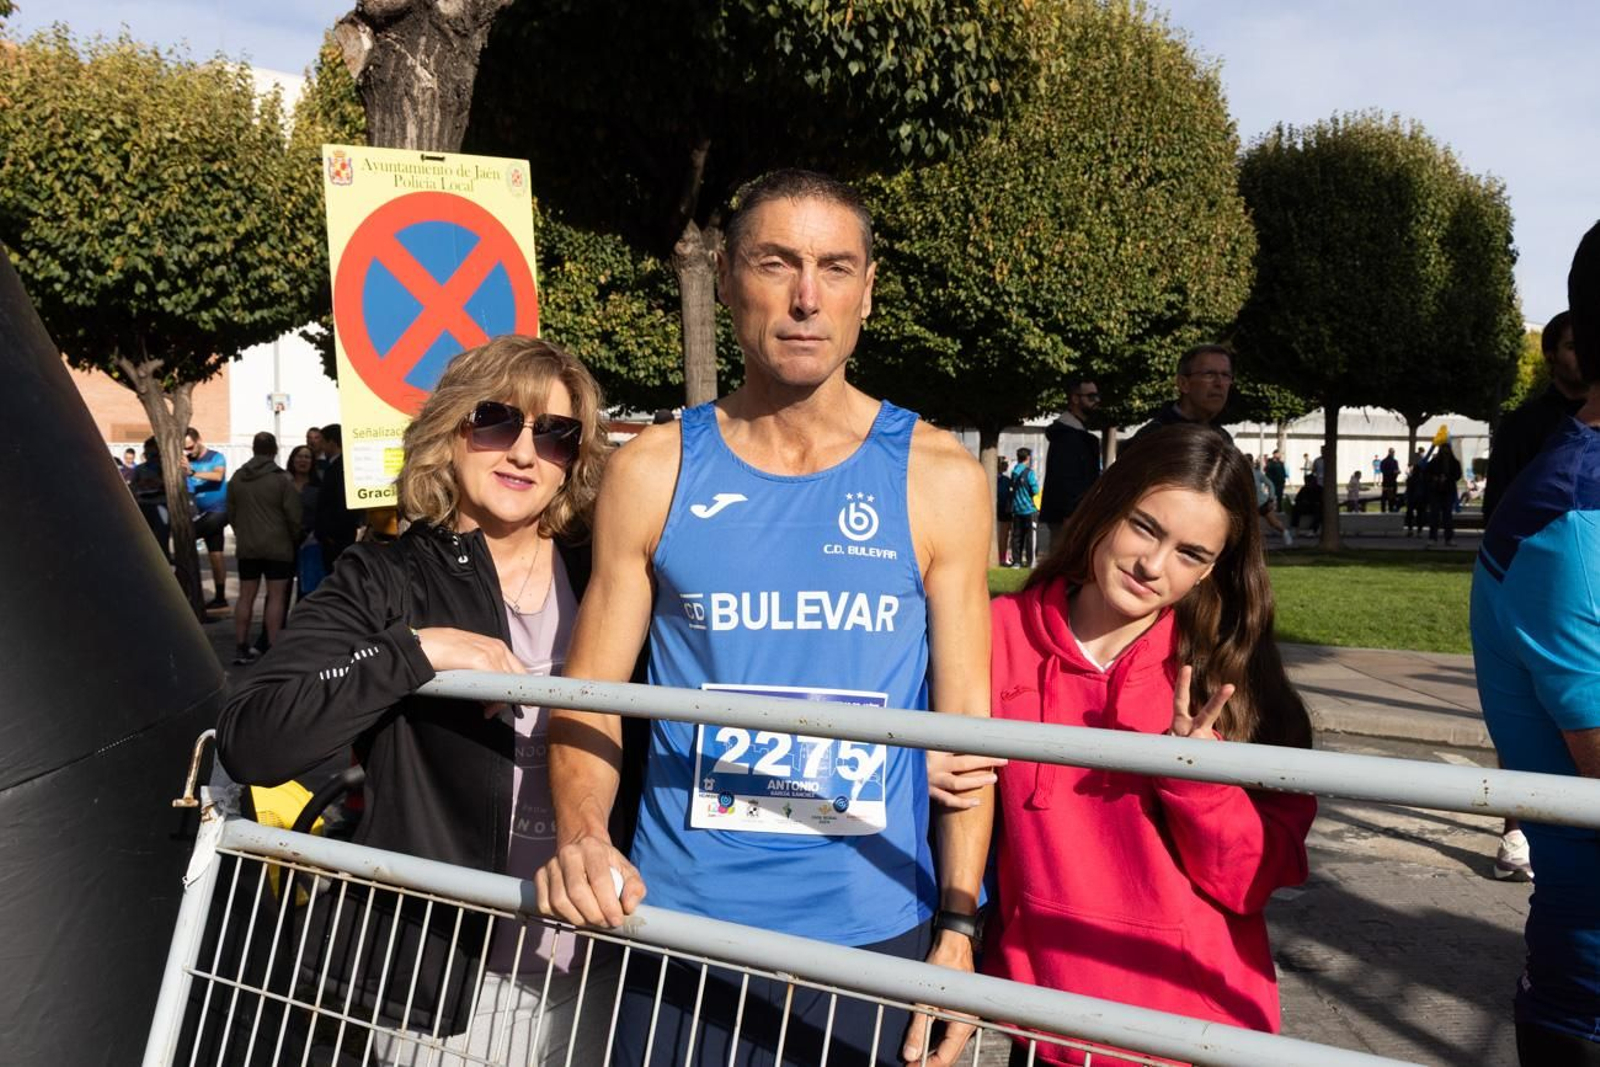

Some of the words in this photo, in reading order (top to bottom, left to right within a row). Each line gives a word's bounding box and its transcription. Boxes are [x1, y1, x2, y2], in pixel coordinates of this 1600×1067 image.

[361, 157, 453, 175] Ayuntamiento
[456, 165, 472, 178] de
[474, 165, 501, 181] Jaén
[440, 177, 474, 192] Local
[823, 543, 845, 555] C.D.
[847, 545, 897, 560] BULEVAR
[683, 602, 705, 621] CD
[710, 590, 900, 633] BULEVAR
[713, 726, 869, 781] 2275
[766, 779, 820, 792] ANTONIO
